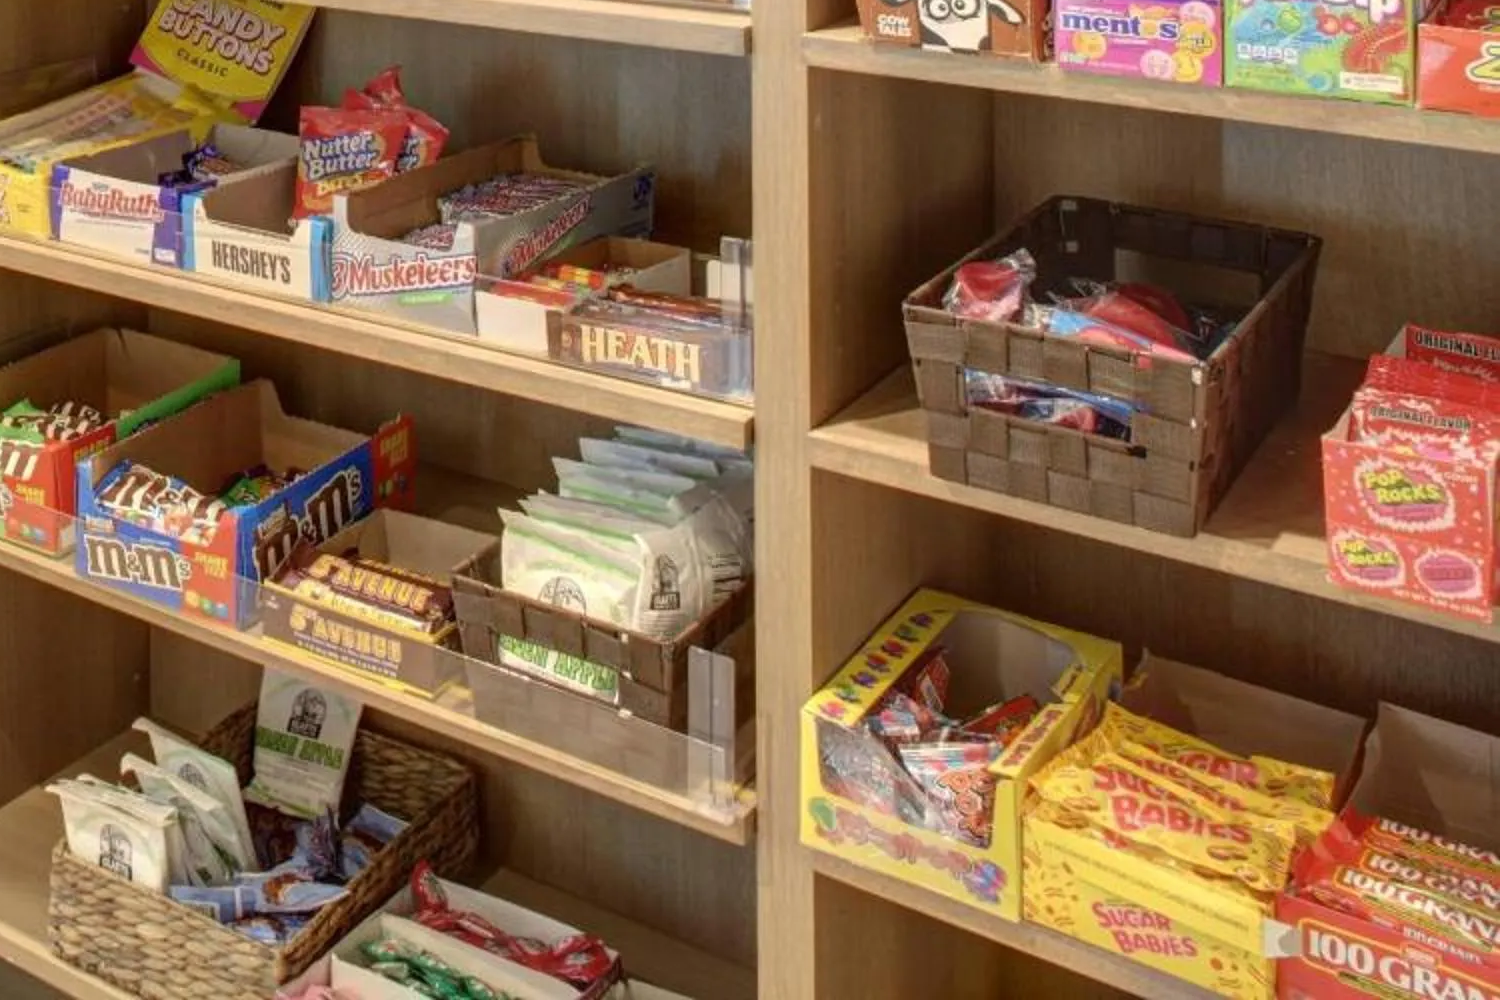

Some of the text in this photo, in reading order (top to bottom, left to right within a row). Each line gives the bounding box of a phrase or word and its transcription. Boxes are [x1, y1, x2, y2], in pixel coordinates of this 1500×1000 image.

[157, 9, 275, 77] BUTTONS
[176, 46, 231, 78] CLASSIC
[303, 131, 373, 161] Nutter
[309, 152, 377, 180] Butter
[211, 240, 291, 284] HERSHEY'S
[348, 253, 477, 293] Musketeers
[580, 324, 701, 380] HEATH
[1363, 469, 1403, 489] POP
[1376, 483, 1442, 505] ROCKS
[87, 537, 192, 589] m&m's
[1111, 795, 1253, 844] BABIES
[1368, 853, 1423, 882] 100
[1091, 902, 1173, 932] SUGAR
[1109, 928, 1200, 959] BABIES
[1308, 929, 1375, 975] 100
